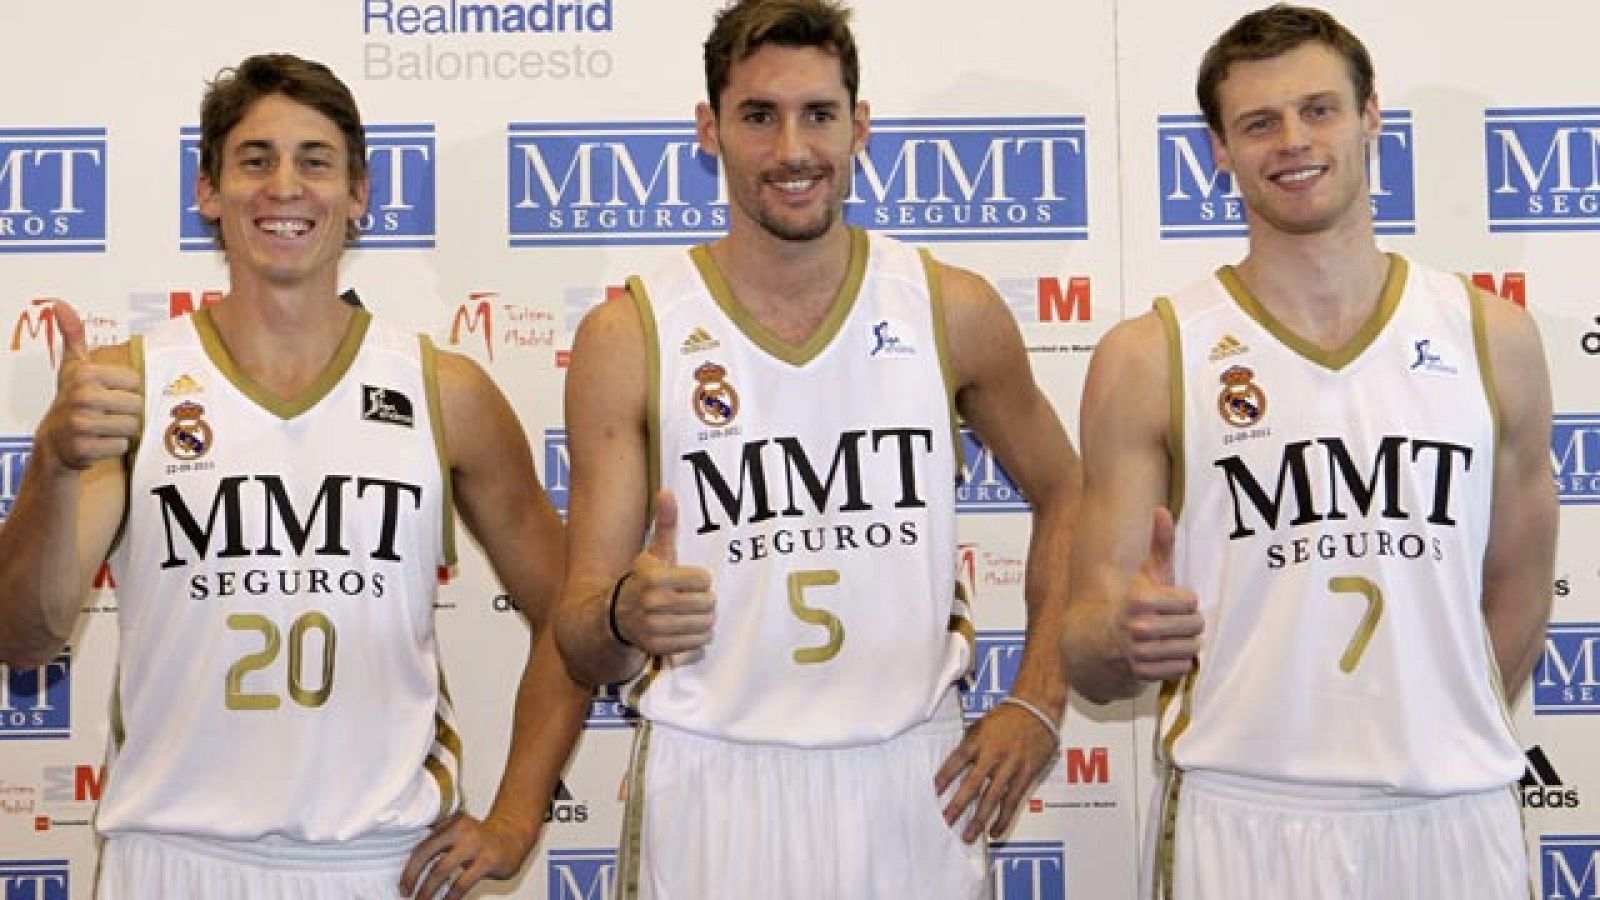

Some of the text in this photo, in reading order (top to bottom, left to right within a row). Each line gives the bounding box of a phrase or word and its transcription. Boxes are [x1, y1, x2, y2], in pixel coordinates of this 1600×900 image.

[364, 42, 613, 80] Baloncesto
[549, 209, 726, 229] SEGUROS
[875, 204, 1053, 224] SEGUROS
[681, 427, 933, 535] MMT
[1213, 434, 1474, 540] MMT
[150, 475, 422, 569] MMT
[728, 521, 919, 563] SEGUROS
[1266, 529, 1444, 569] SEGUROS
[190, 569, 386, 600] SEGUROS
[786, 569, 846, 666] 5
[1327, 577, 1385, 674] 7
[225, 611, 336, 711] 20
